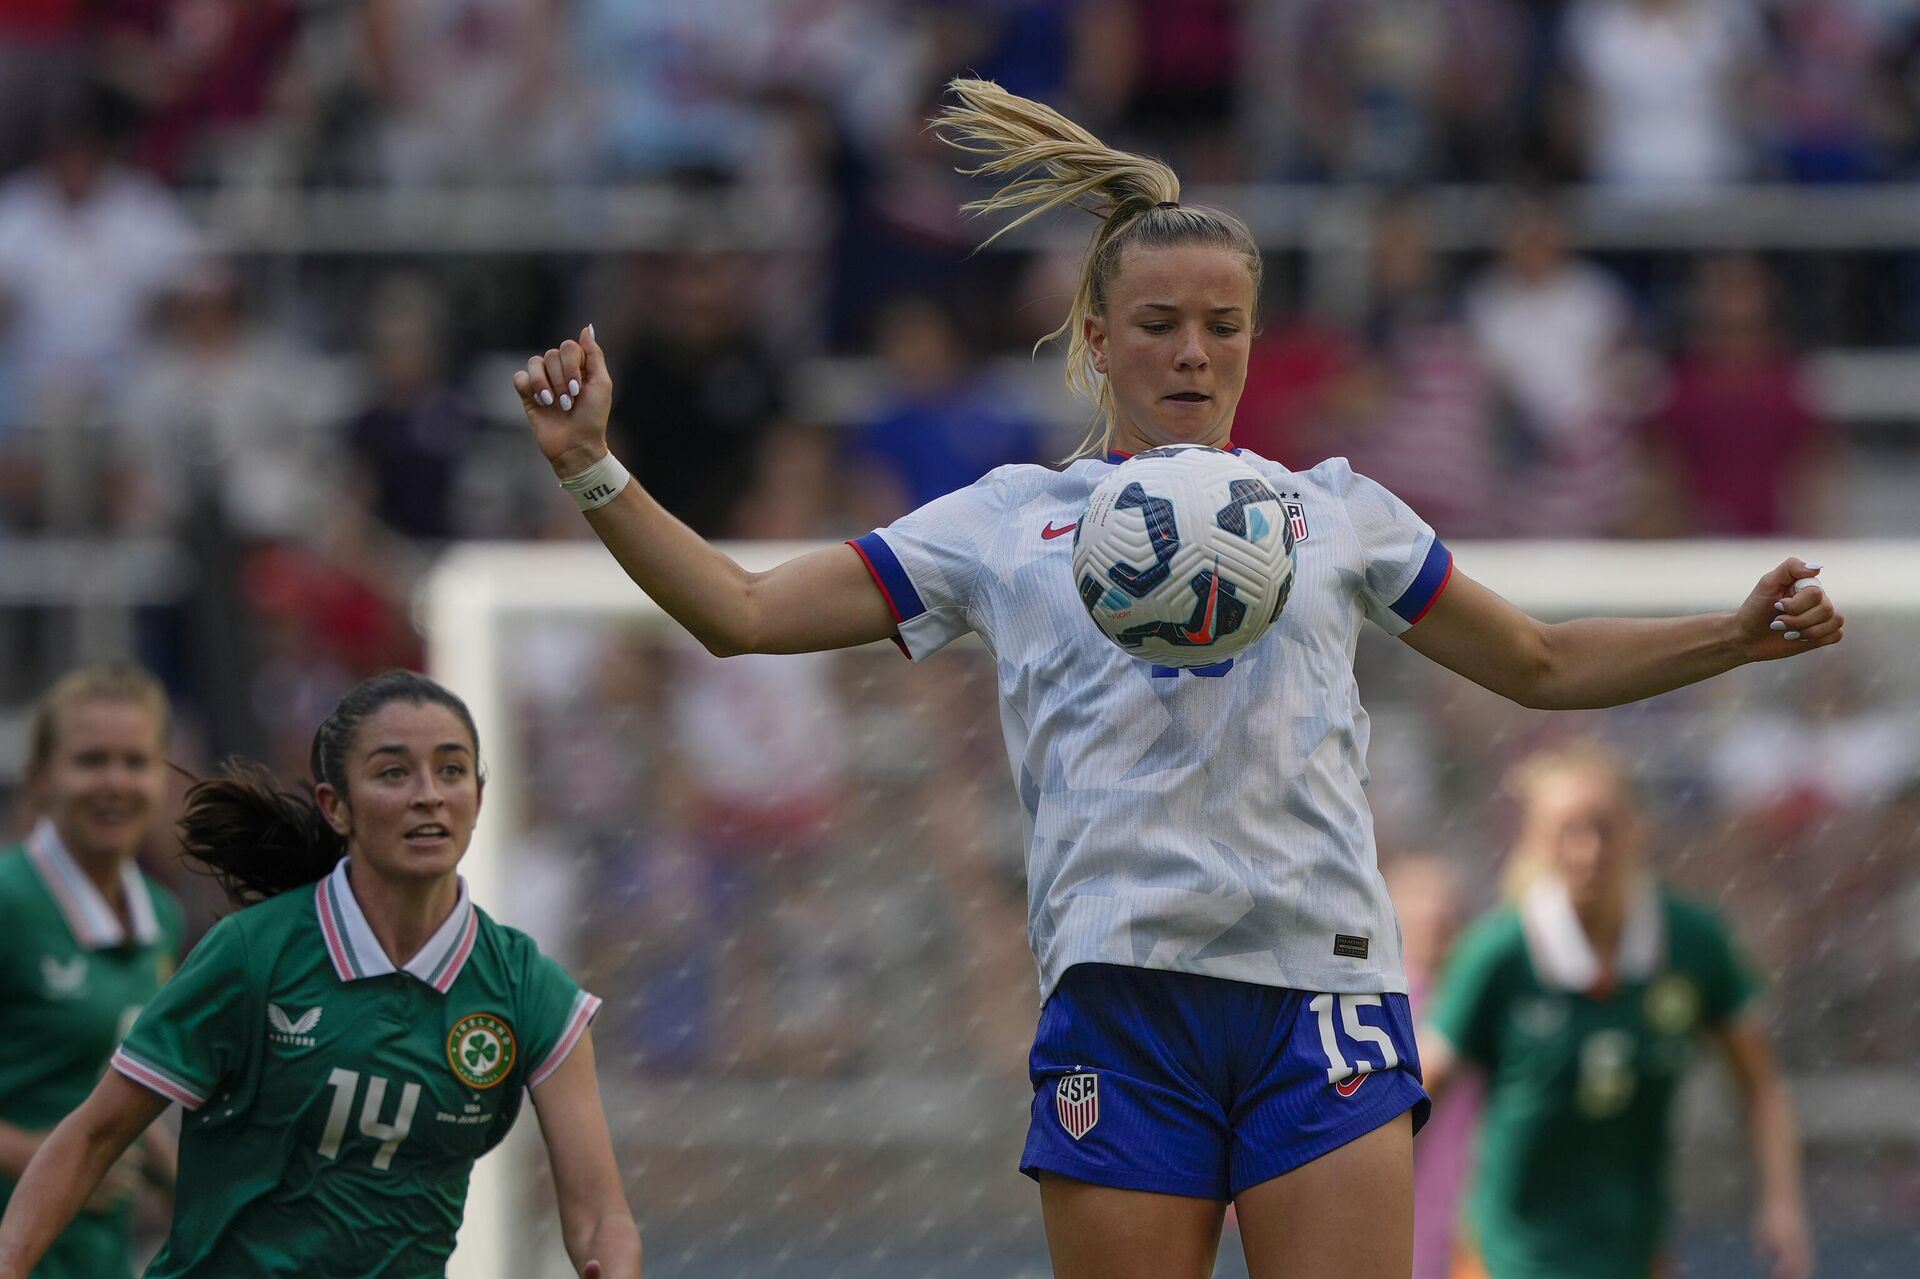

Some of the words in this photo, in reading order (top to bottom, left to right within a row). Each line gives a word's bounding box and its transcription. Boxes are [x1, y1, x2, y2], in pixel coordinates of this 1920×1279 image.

[1309, 993, 1399, 1084] 15
[317, 1067, 422, 1171] 14
[1059, 1076, 1095, 1102] USA
